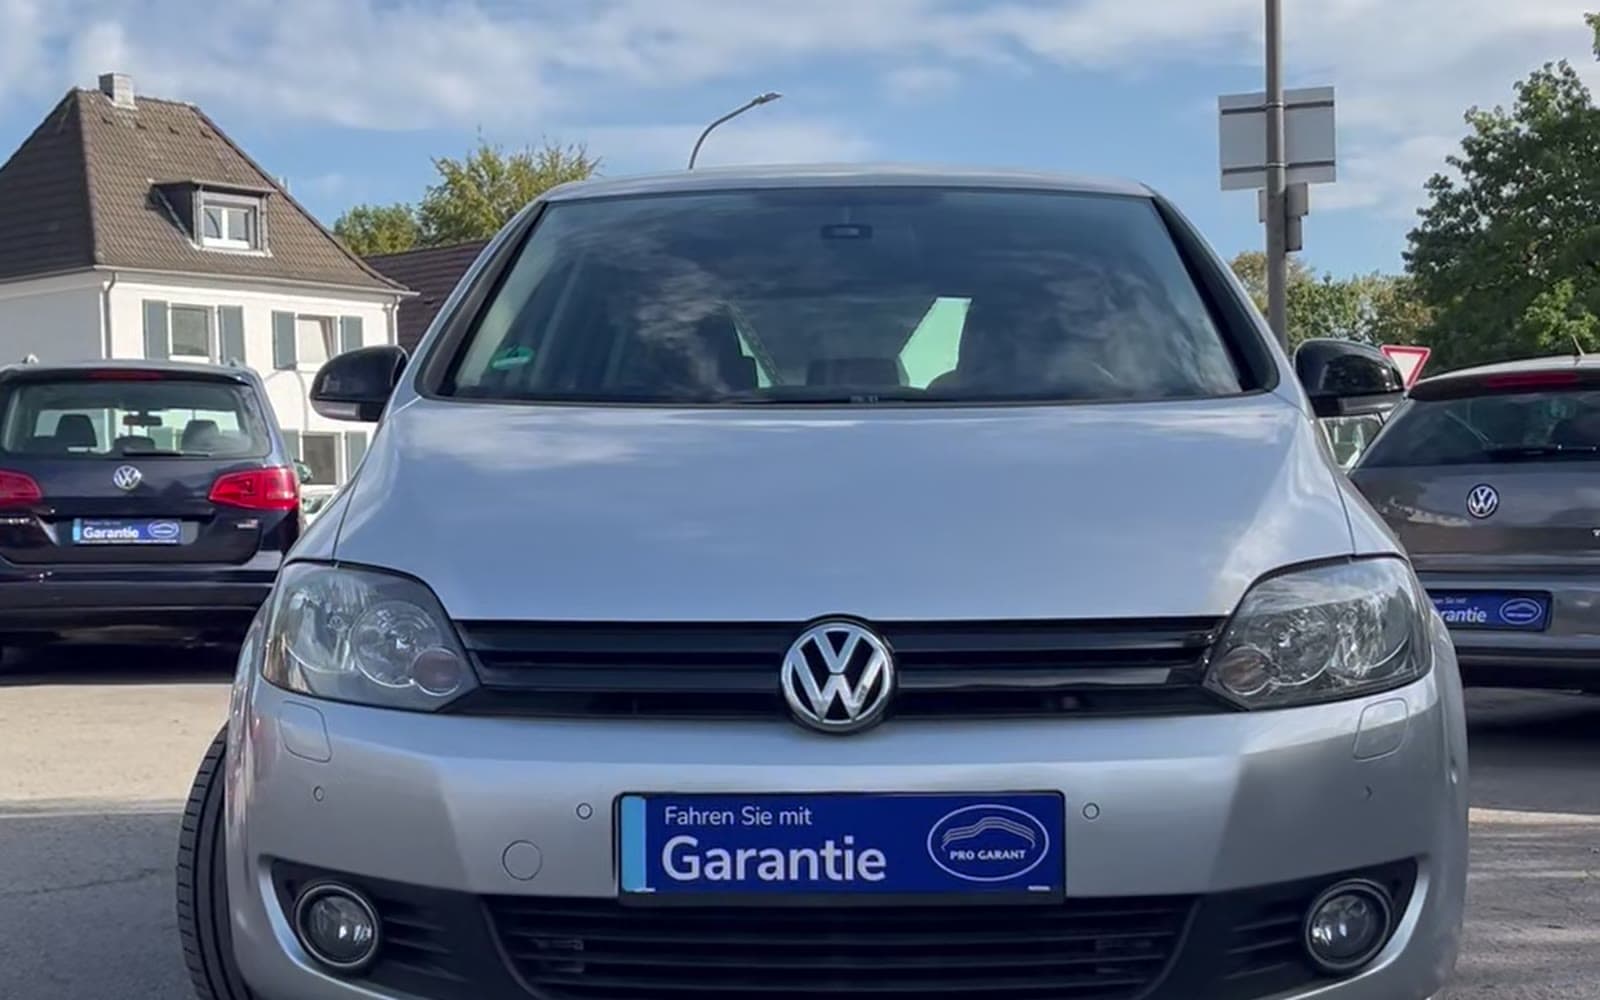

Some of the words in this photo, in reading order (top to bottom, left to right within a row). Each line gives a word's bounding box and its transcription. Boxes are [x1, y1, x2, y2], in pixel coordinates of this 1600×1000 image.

[113, 465, 142, 490] VW
[1467, 485, 1498, 517] VW
[1440, 606, 1488, 623] rantie
[781, 622, 892, 726] VW
[664, 806, 735, 826] Fahren
[741, 806, 773, 826] Sie
[779, 806, 813, 826] mit
[661, 834, 887, 882] Garantie
[949, 850, 975, 861] PRO
[977, 849, 1027, 861] GARANT
